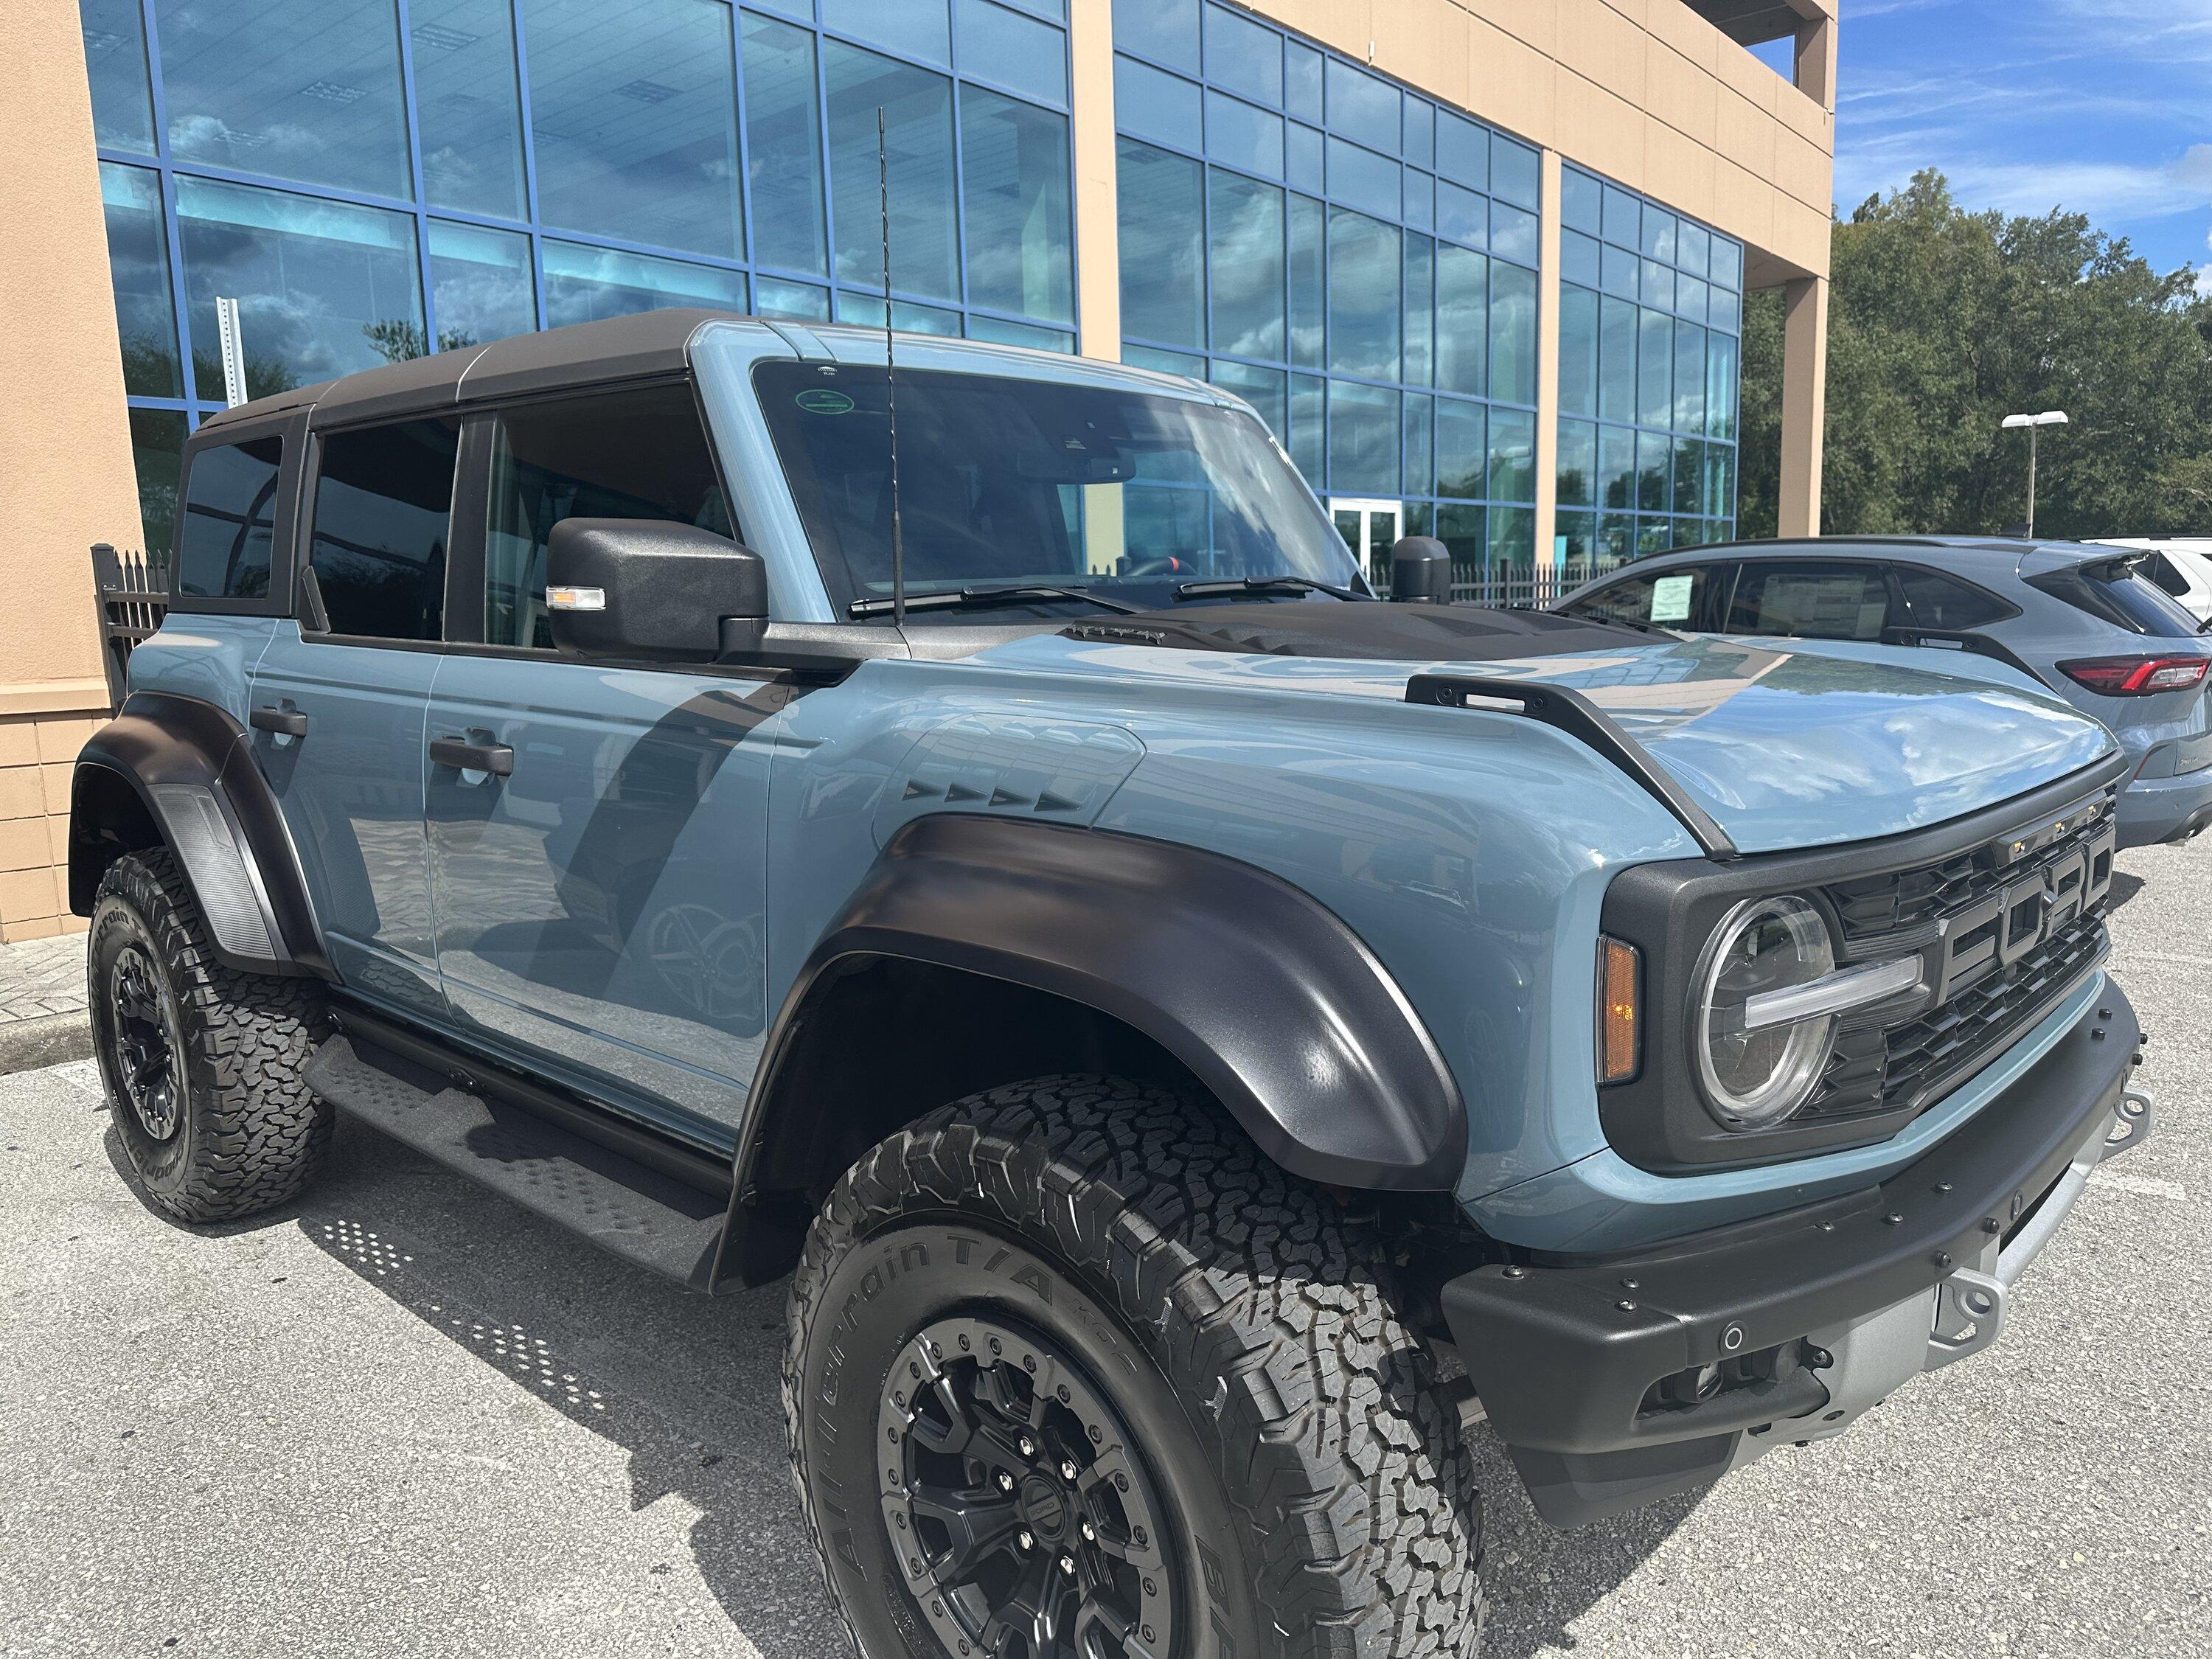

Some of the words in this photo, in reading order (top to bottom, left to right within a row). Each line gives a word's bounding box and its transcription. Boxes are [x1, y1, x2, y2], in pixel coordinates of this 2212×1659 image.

[1936, 824, 2115, 1006] FORD
[946, 1234, 1054, 1307] T/A
[1030, 1502, 1055, 1516] FORD
